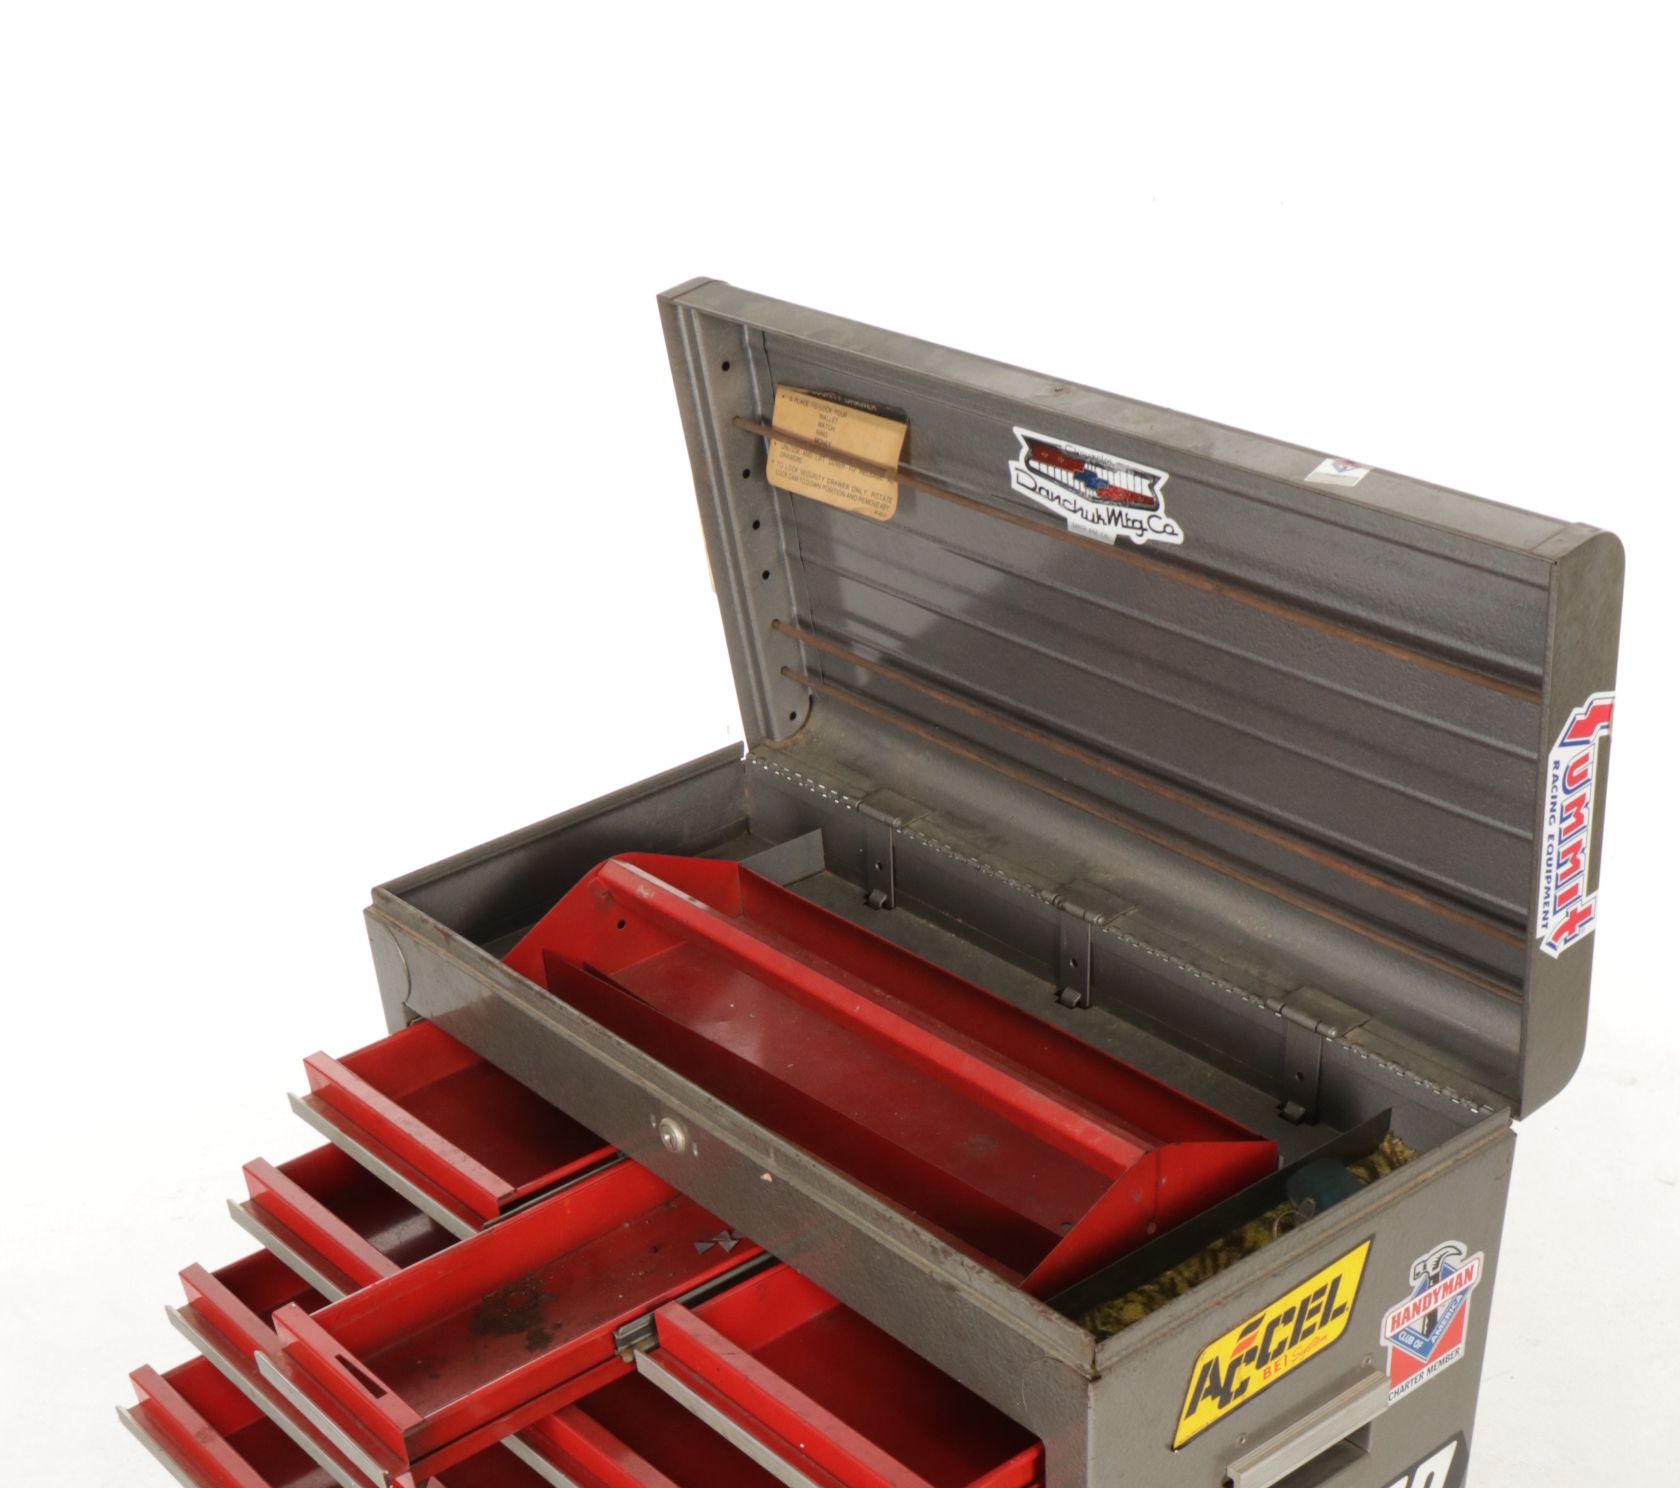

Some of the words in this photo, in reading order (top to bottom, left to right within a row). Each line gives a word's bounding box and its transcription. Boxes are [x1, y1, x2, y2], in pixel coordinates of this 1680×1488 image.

[1015, 467, 1107, 526] Danchuk
[1548, 760, 1561, 826] RACING
[1540, 834, 1555, 930] EQUIPMENT
[1390, 1263, 1476, 1333] HANDYMAN
[1398, 1331, 1413, 1345] CLUB
[1413, 1338, 1424, 1351] OF
[1431, 1294, 1463, 1344] AMERICA
[1185, 1274, 1348, 1419] ACCEL
[1262, 1359, 1288, 1382] BEI
[1389, 1371, 1425, 1402] CHARTER
[1426, 1347, 1460, 1377] MEMBER
